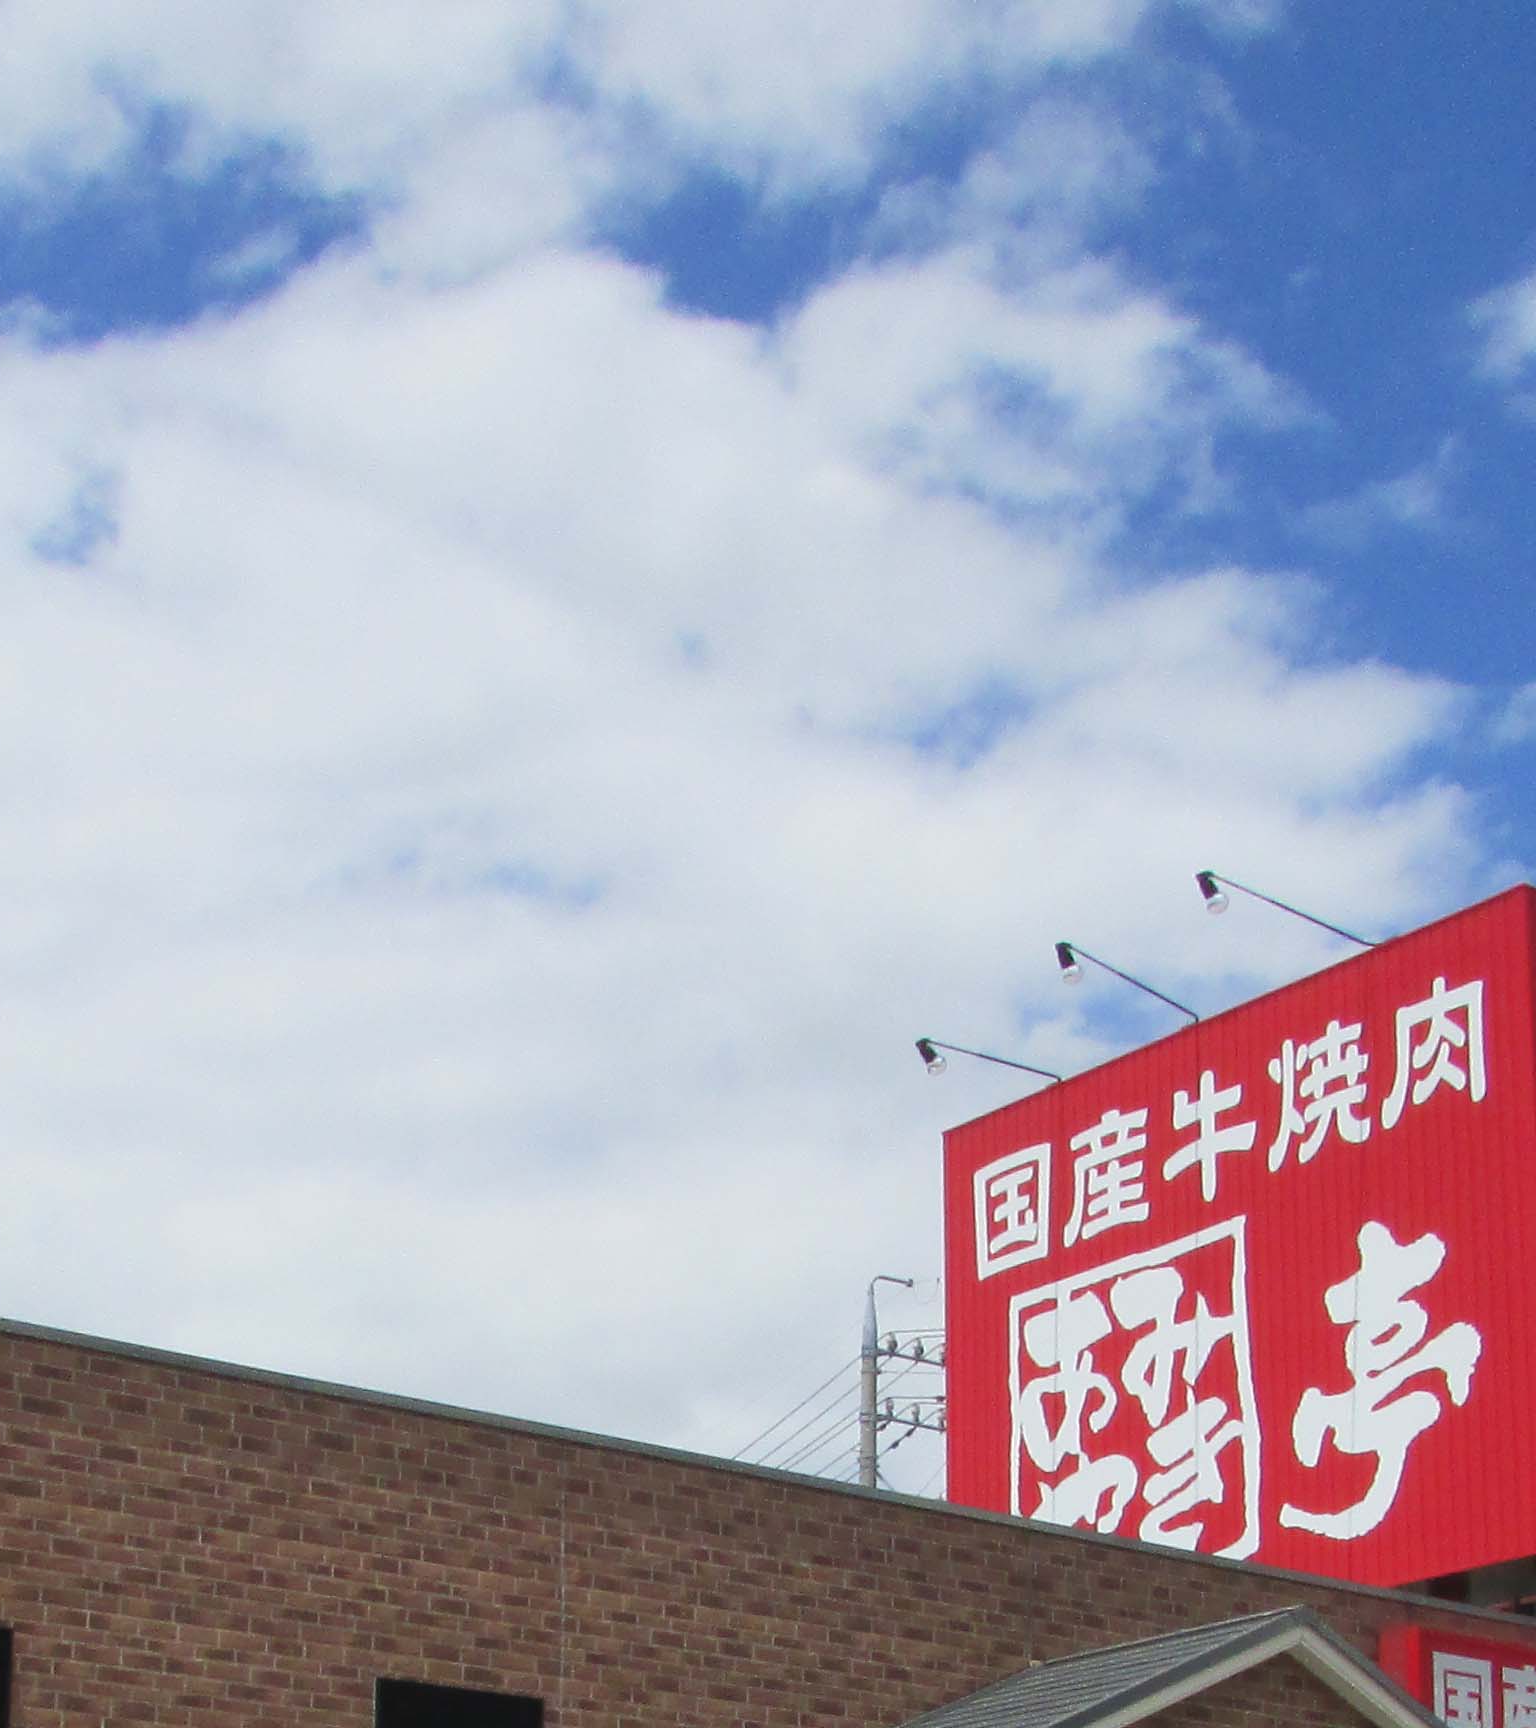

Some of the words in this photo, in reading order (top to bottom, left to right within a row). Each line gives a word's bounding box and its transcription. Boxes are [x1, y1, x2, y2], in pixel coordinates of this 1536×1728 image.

[972, 976, 1485, 1281] 国産牛焼肉
